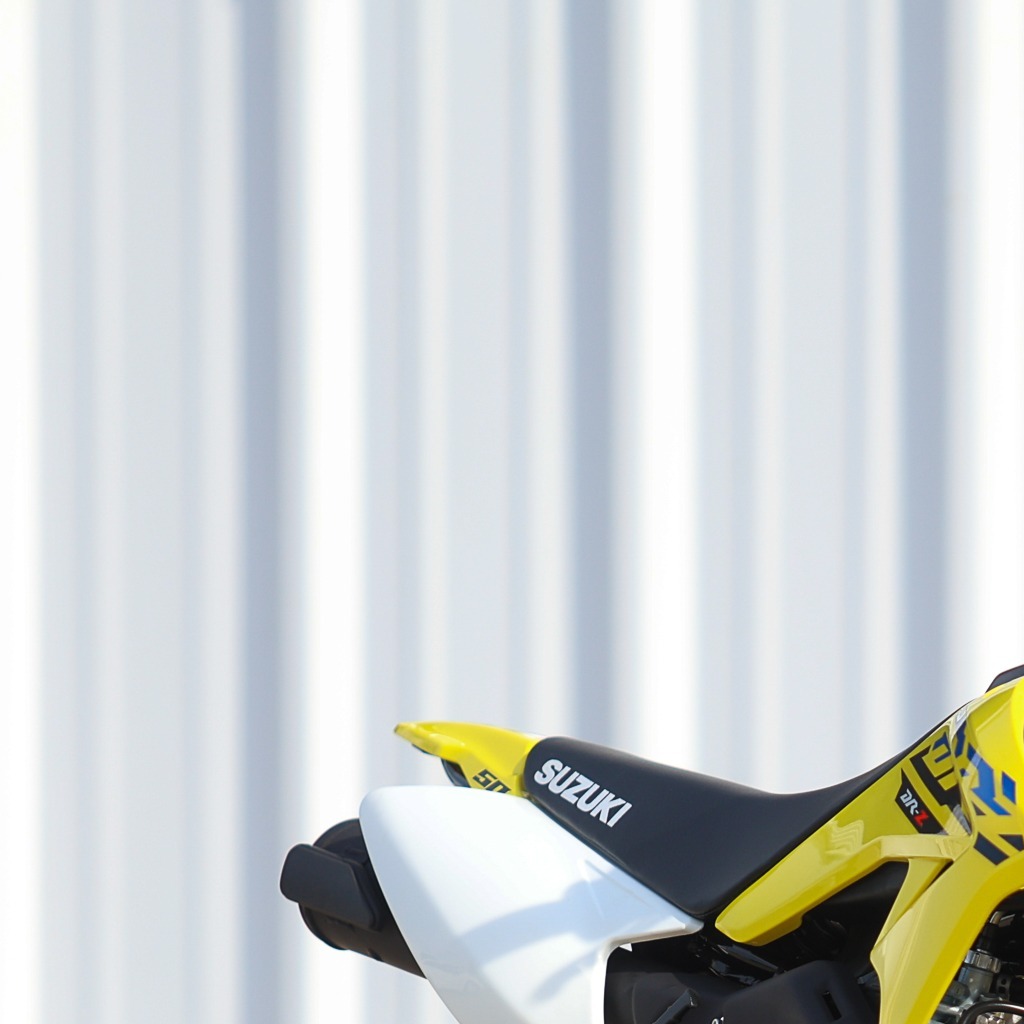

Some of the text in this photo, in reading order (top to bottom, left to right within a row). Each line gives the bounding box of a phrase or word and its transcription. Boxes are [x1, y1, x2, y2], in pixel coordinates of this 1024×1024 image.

[472, 769, 511, 794] 50
[534, 759, 632, 828] SUZUKI
[900, 788, 929, 827] DR-Z
